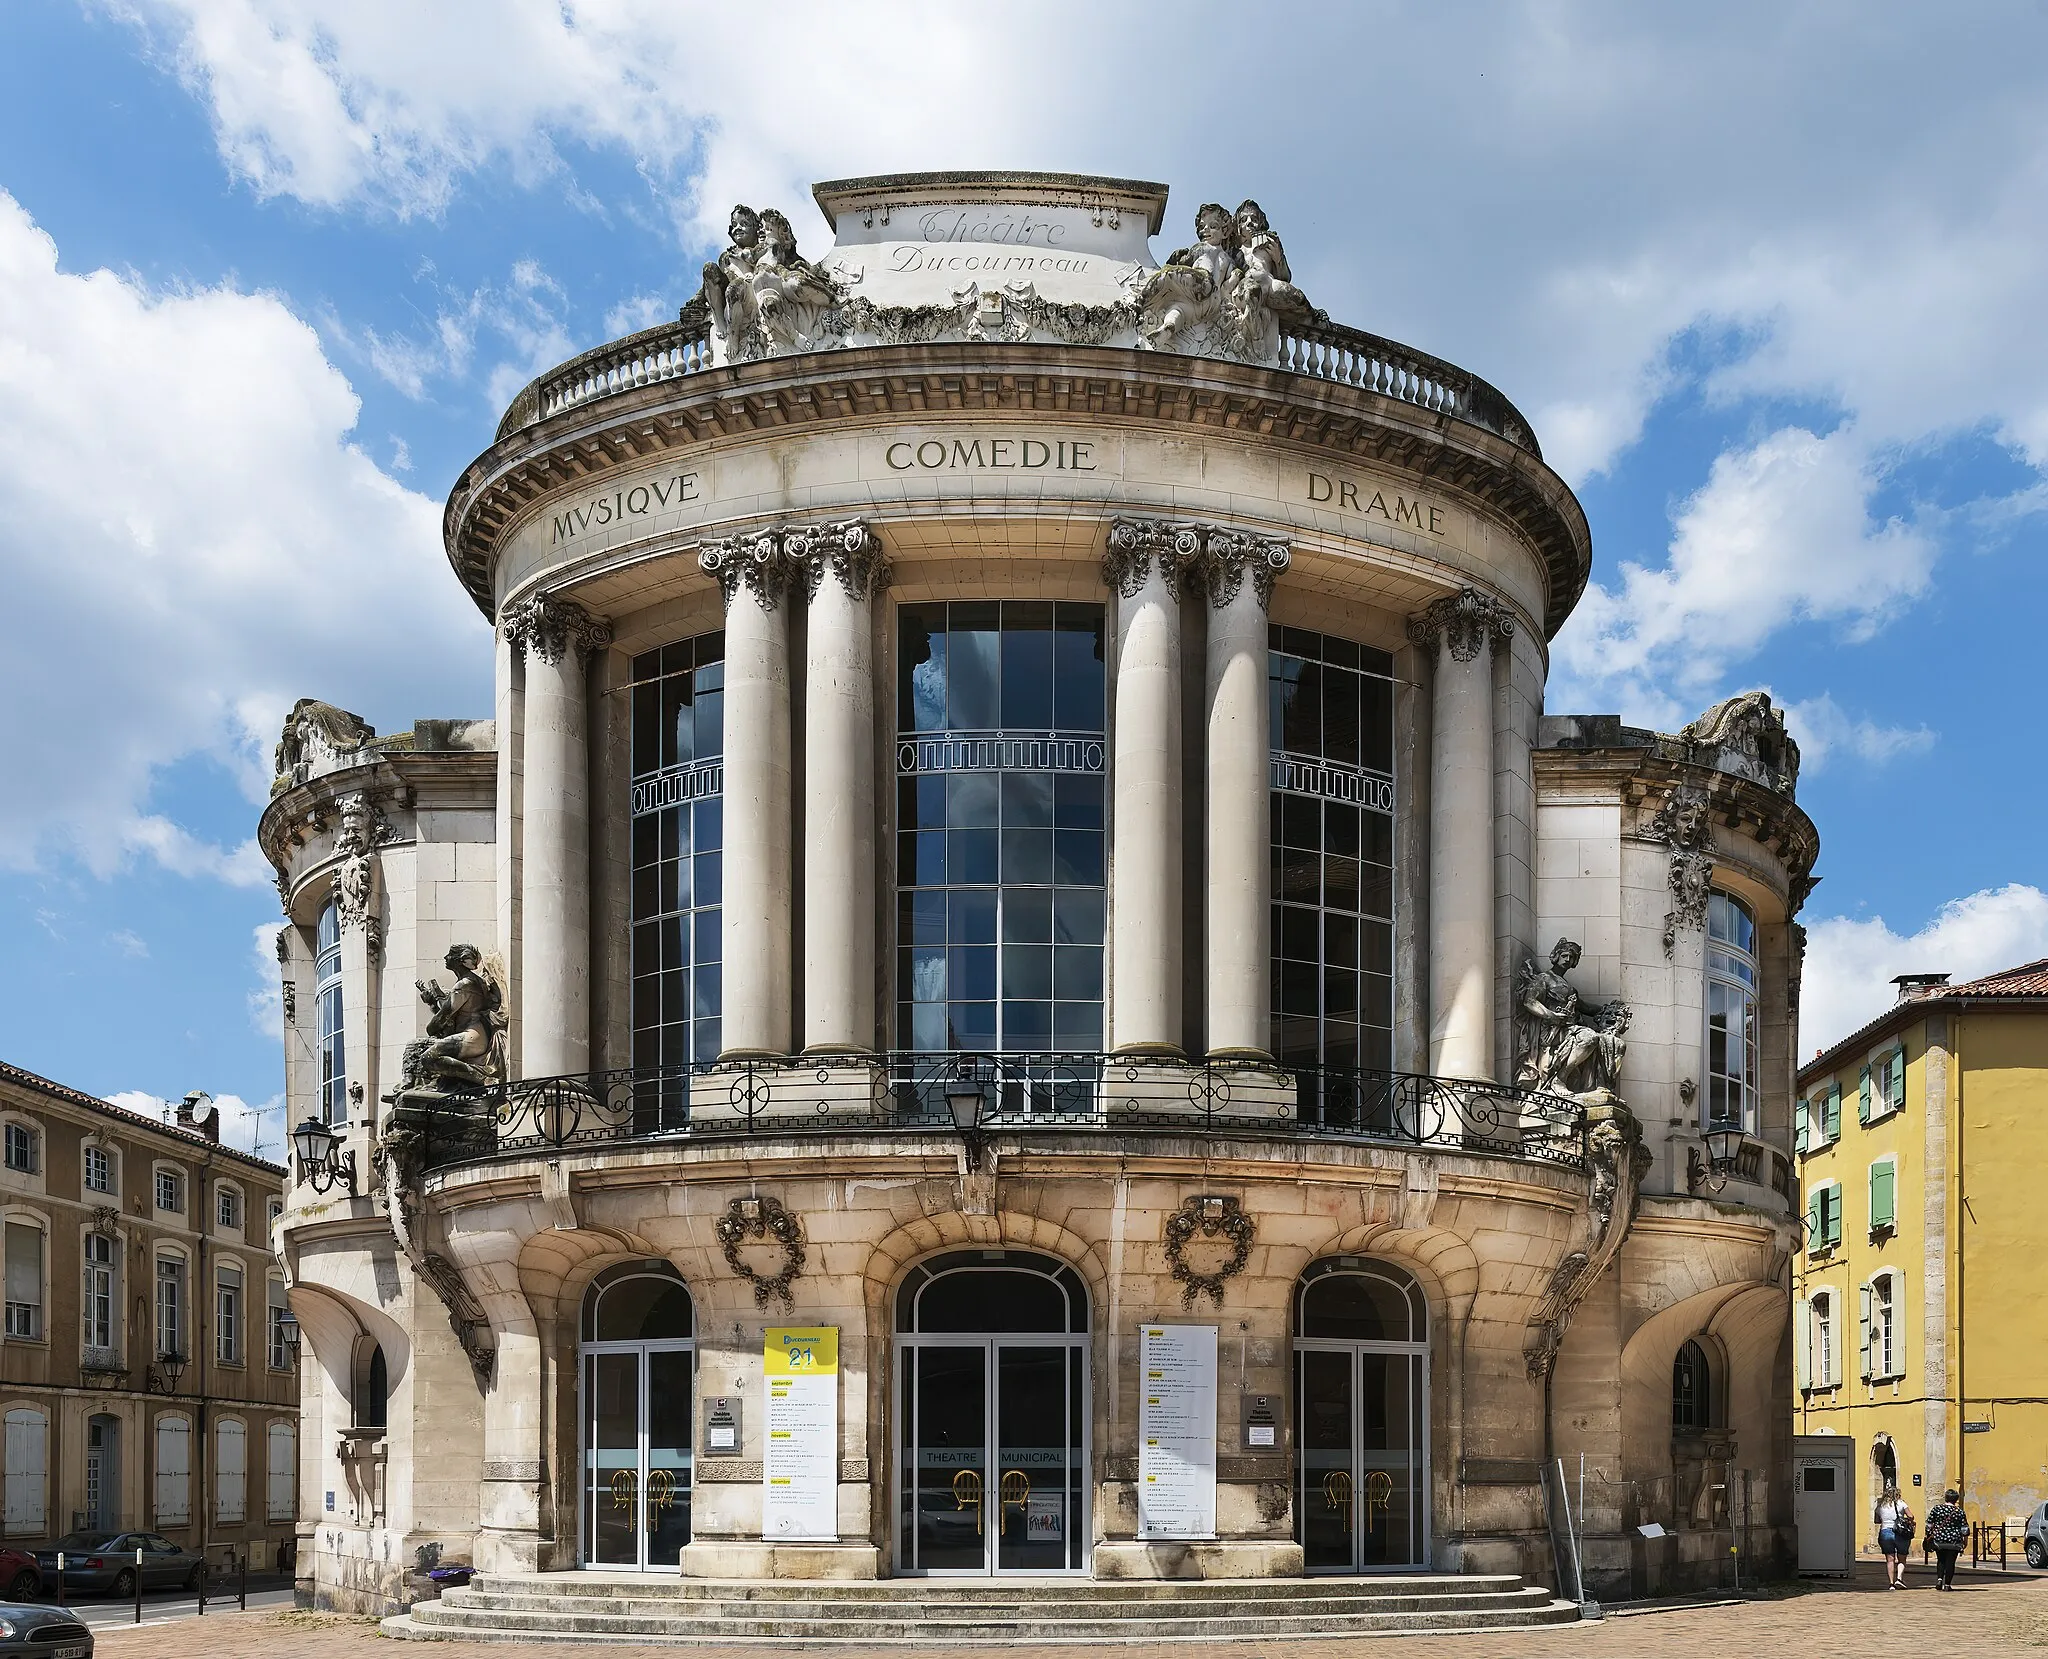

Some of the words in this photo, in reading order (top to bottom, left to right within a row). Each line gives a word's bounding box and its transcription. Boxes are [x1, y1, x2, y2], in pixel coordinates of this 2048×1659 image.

[919, 209, 1066, 245] Théâtre
[885, 246, 1089, 274] Ducourneau
[885, 439, 1098, 471] COMEDIE
[552, 472, 700, 545] MVSIQVE
[1307, 473, 1446, 536] DRAME
[790, 1347, 811, 1366] 21
[926, 1452, 977, 1462] THEATRE
[1001, 1452, 1063, 1462] MUNICIPAL
